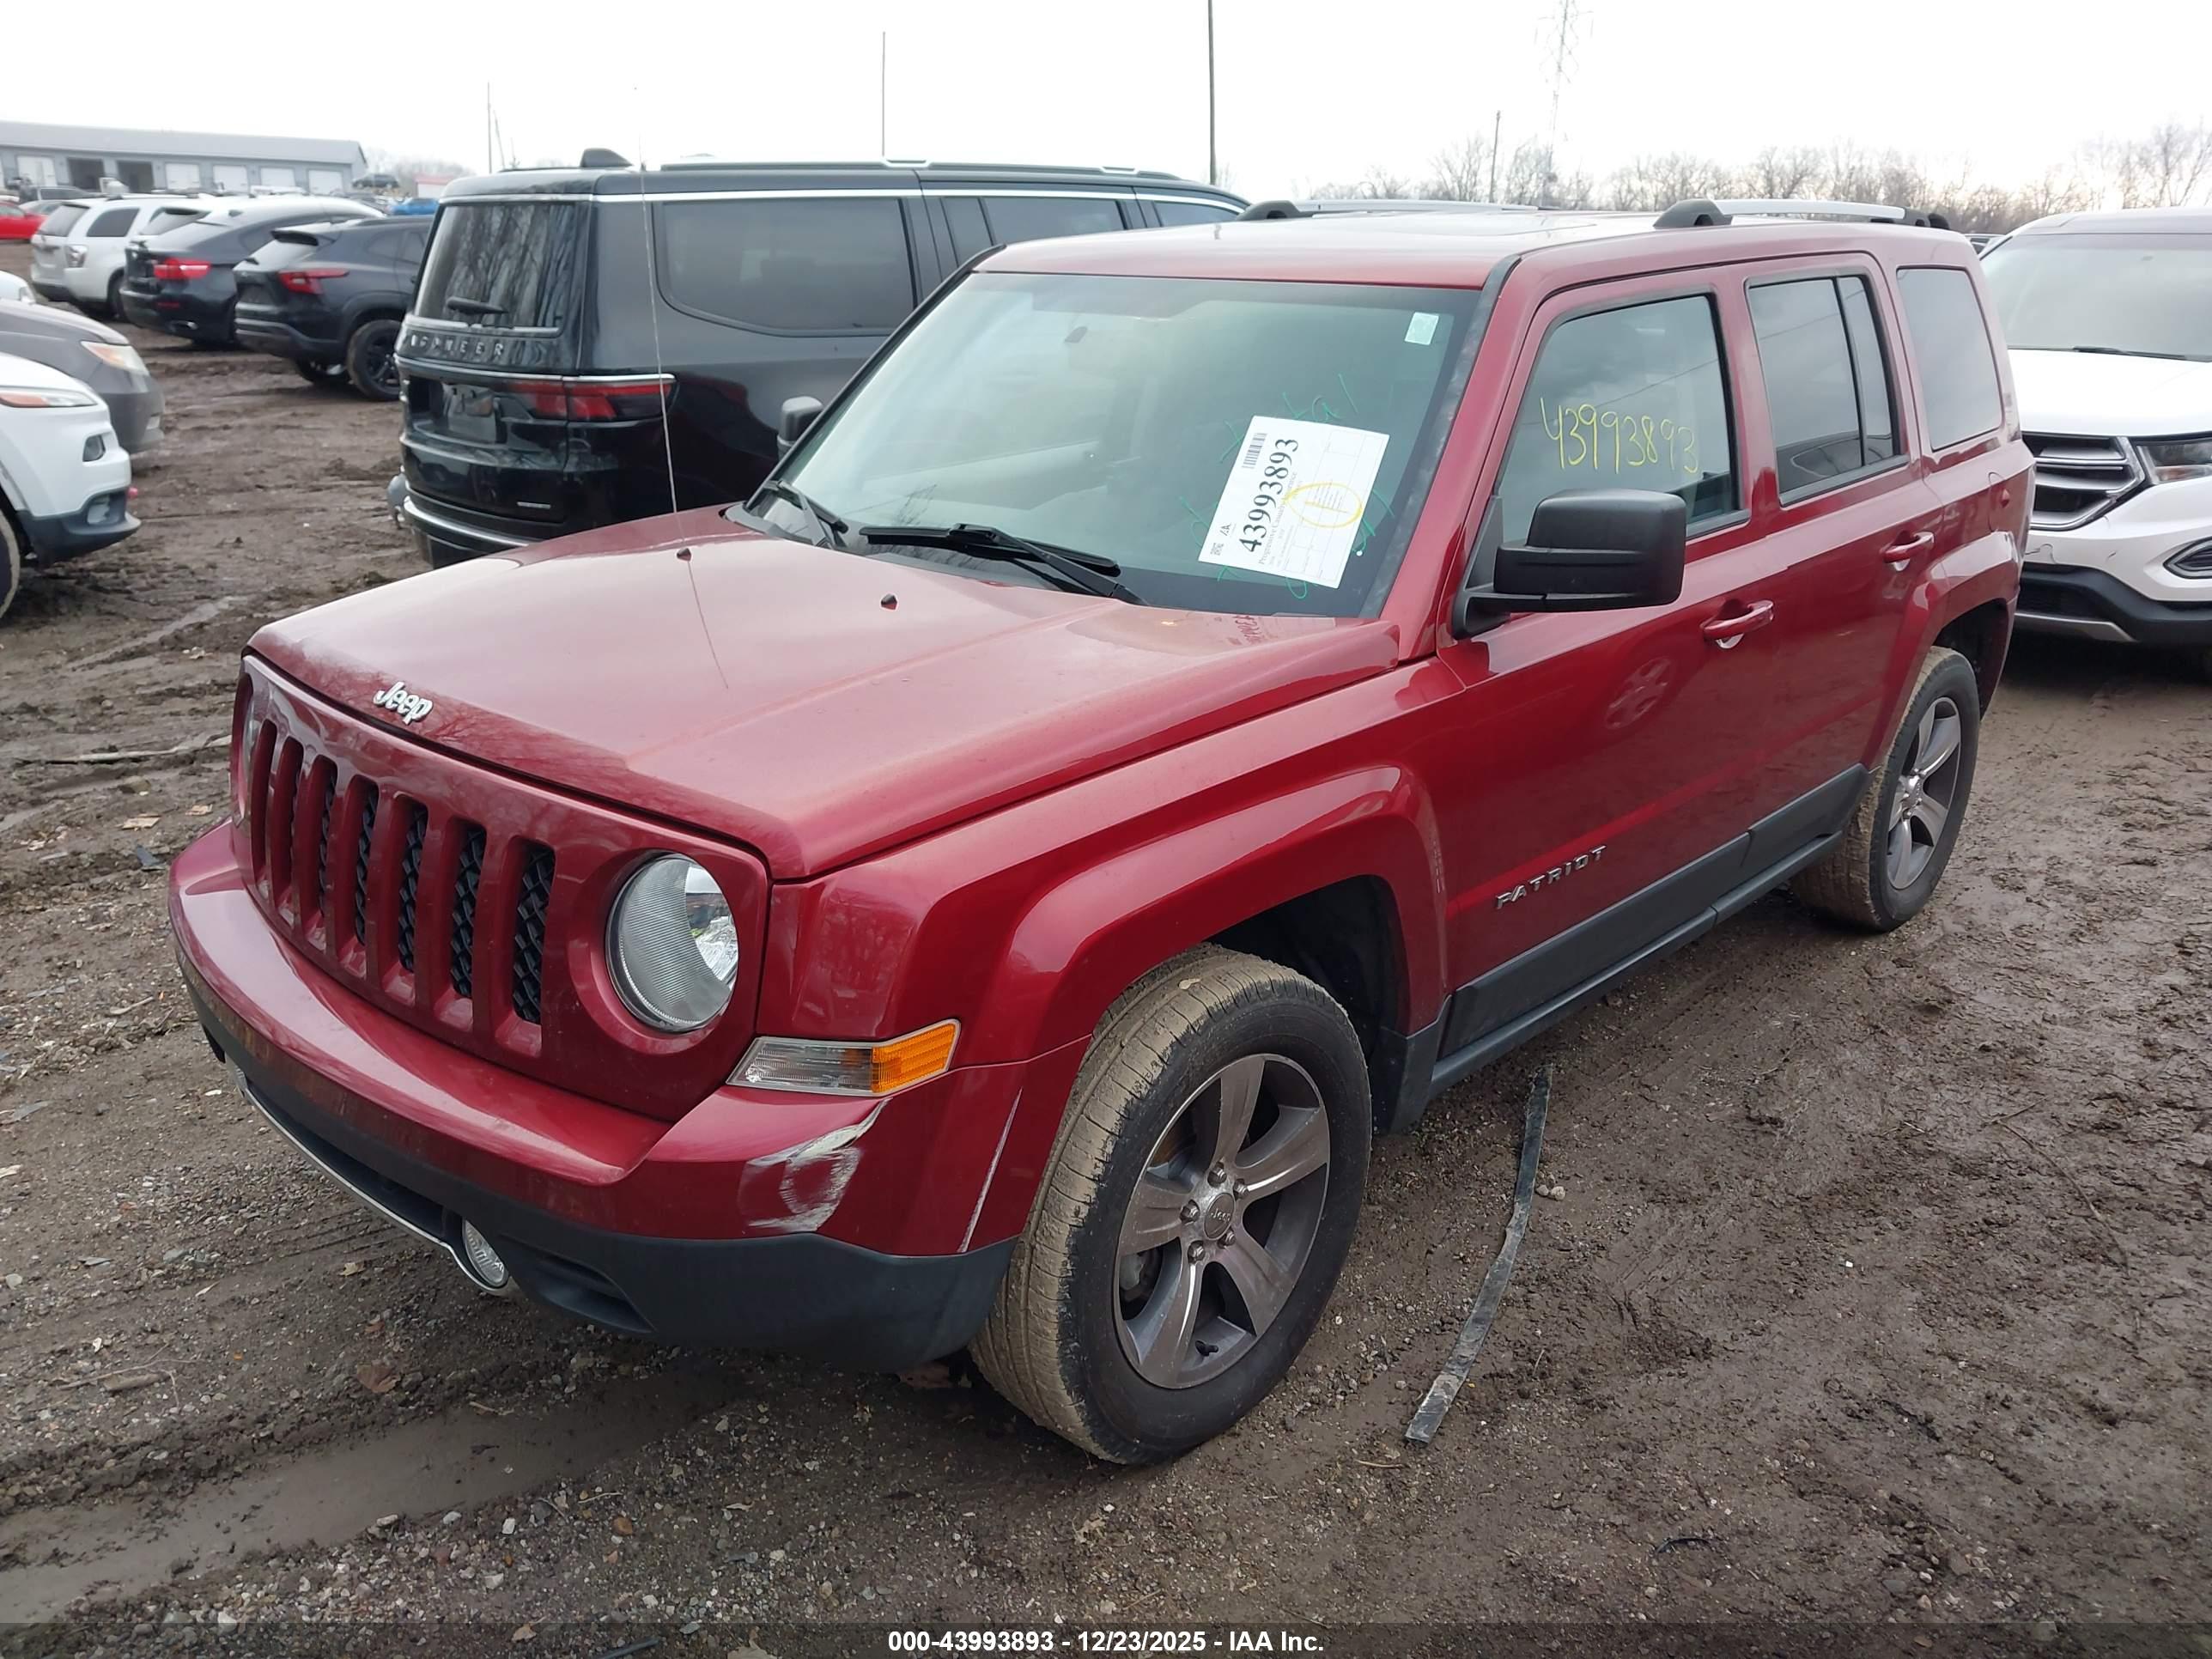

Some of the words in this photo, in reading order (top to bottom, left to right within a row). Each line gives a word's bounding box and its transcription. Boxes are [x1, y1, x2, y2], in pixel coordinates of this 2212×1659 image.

[1540, 397, 1698, 474] 43993893
[1238, 438, 1299, 552] 43993893
[373, 681, 434, 726] Jeep
[1496, 845, 1607, 909] PATRIOT
